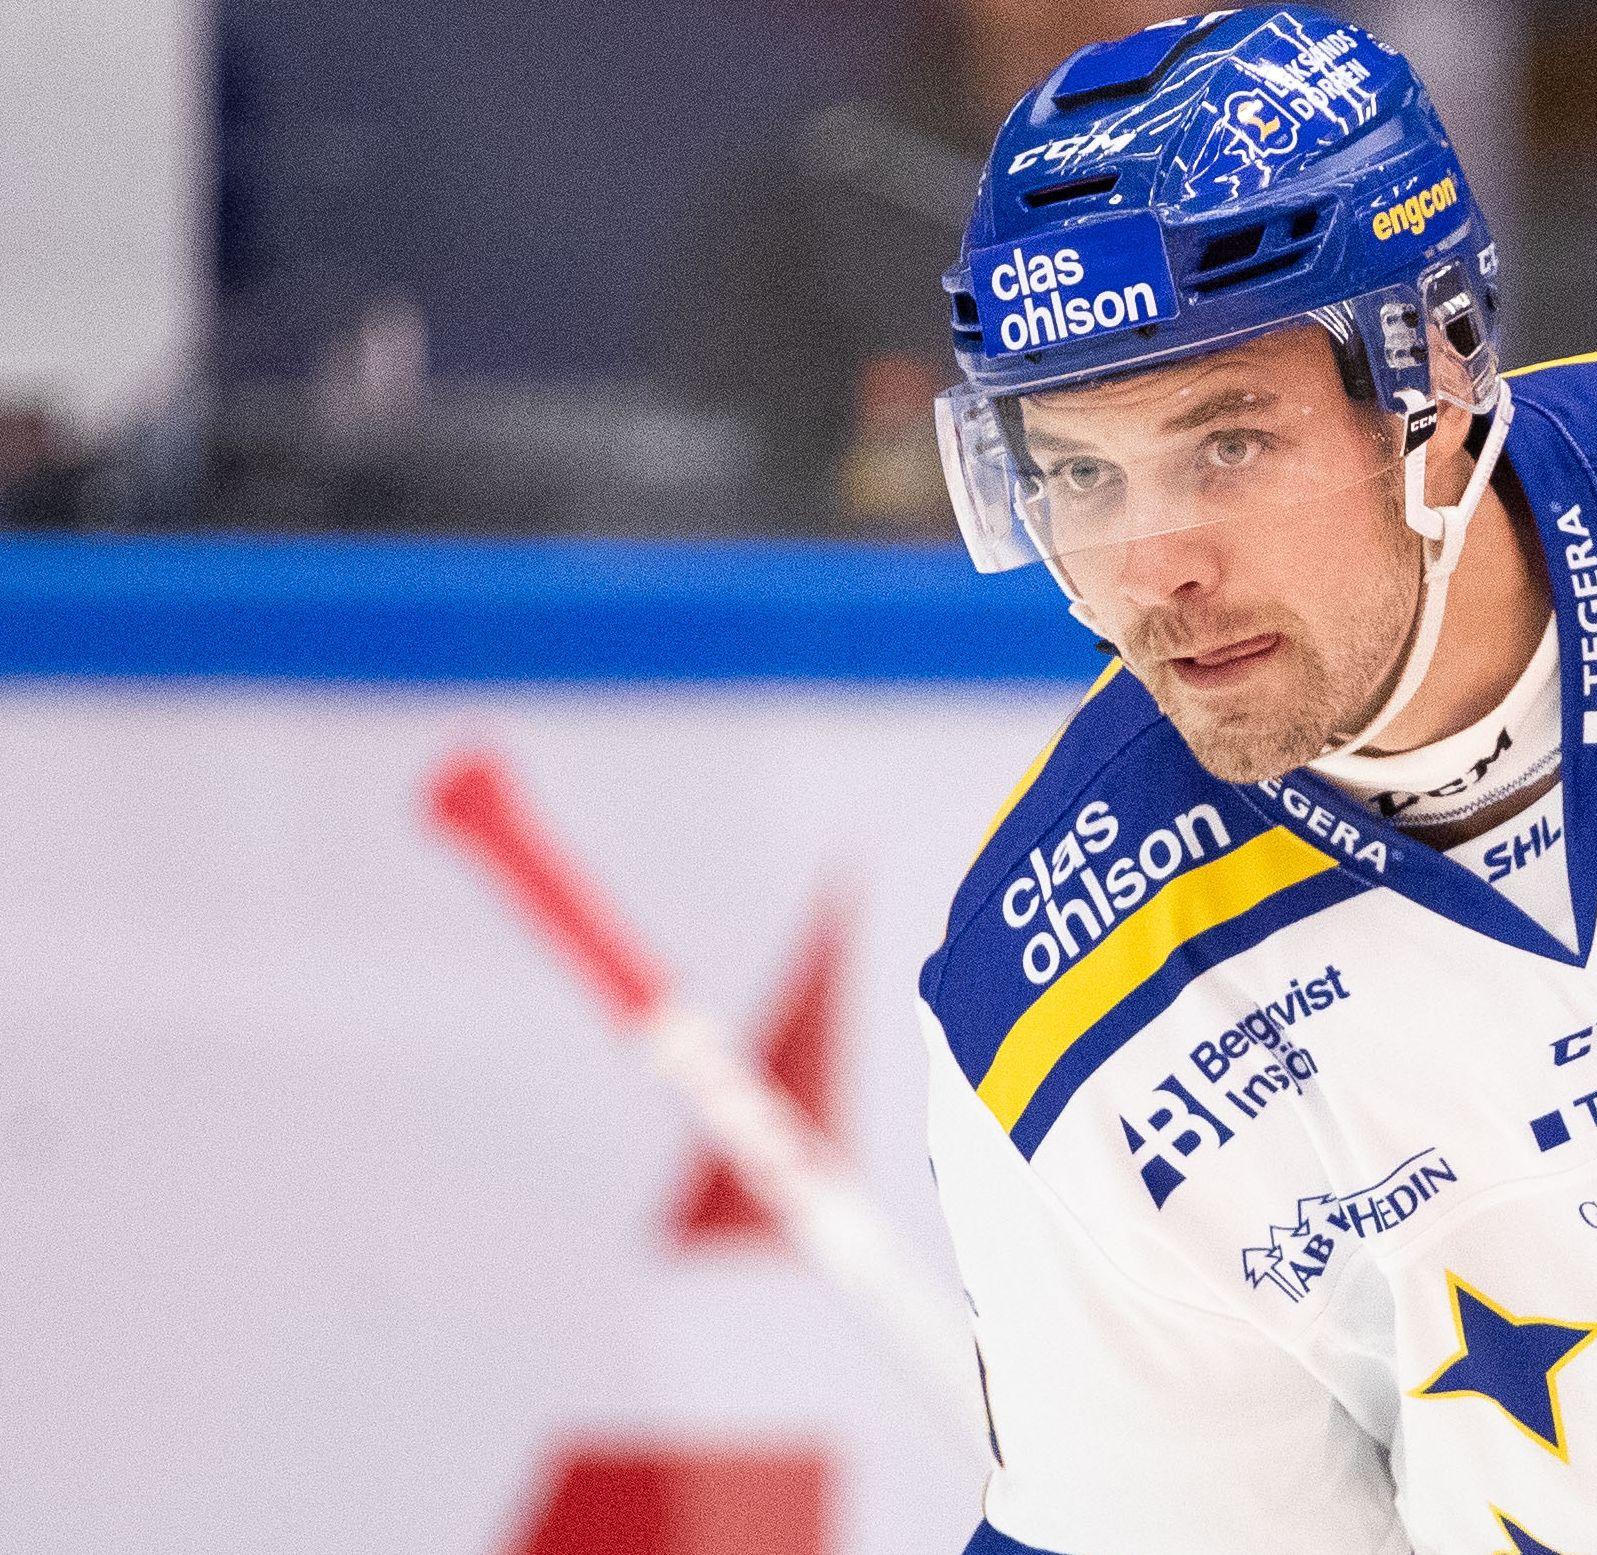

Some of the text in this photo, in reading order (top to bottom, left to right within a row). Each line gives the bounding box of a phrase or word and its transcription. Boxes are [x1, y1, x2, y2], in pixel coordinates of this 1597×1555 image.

[1373, 176, 1458, 241] engcon
[990, 247, 1084, 301] clas
[1000, 282, 1159, 352] ohlson
[1410, 411, 1438, 433] CCM
[1257, 778, 1387, 874] GERA
[1483, 815, 1562, 883] SHL
[1002, 800, 1119, 930] clas
[1021, 803, 1232, 986] ohlson
[1225, 1042, 1319, 1119] Insö
[1289, 1233, 1335, 1294] AB
[1347, 1157, 1458, 1238] HEDIN
